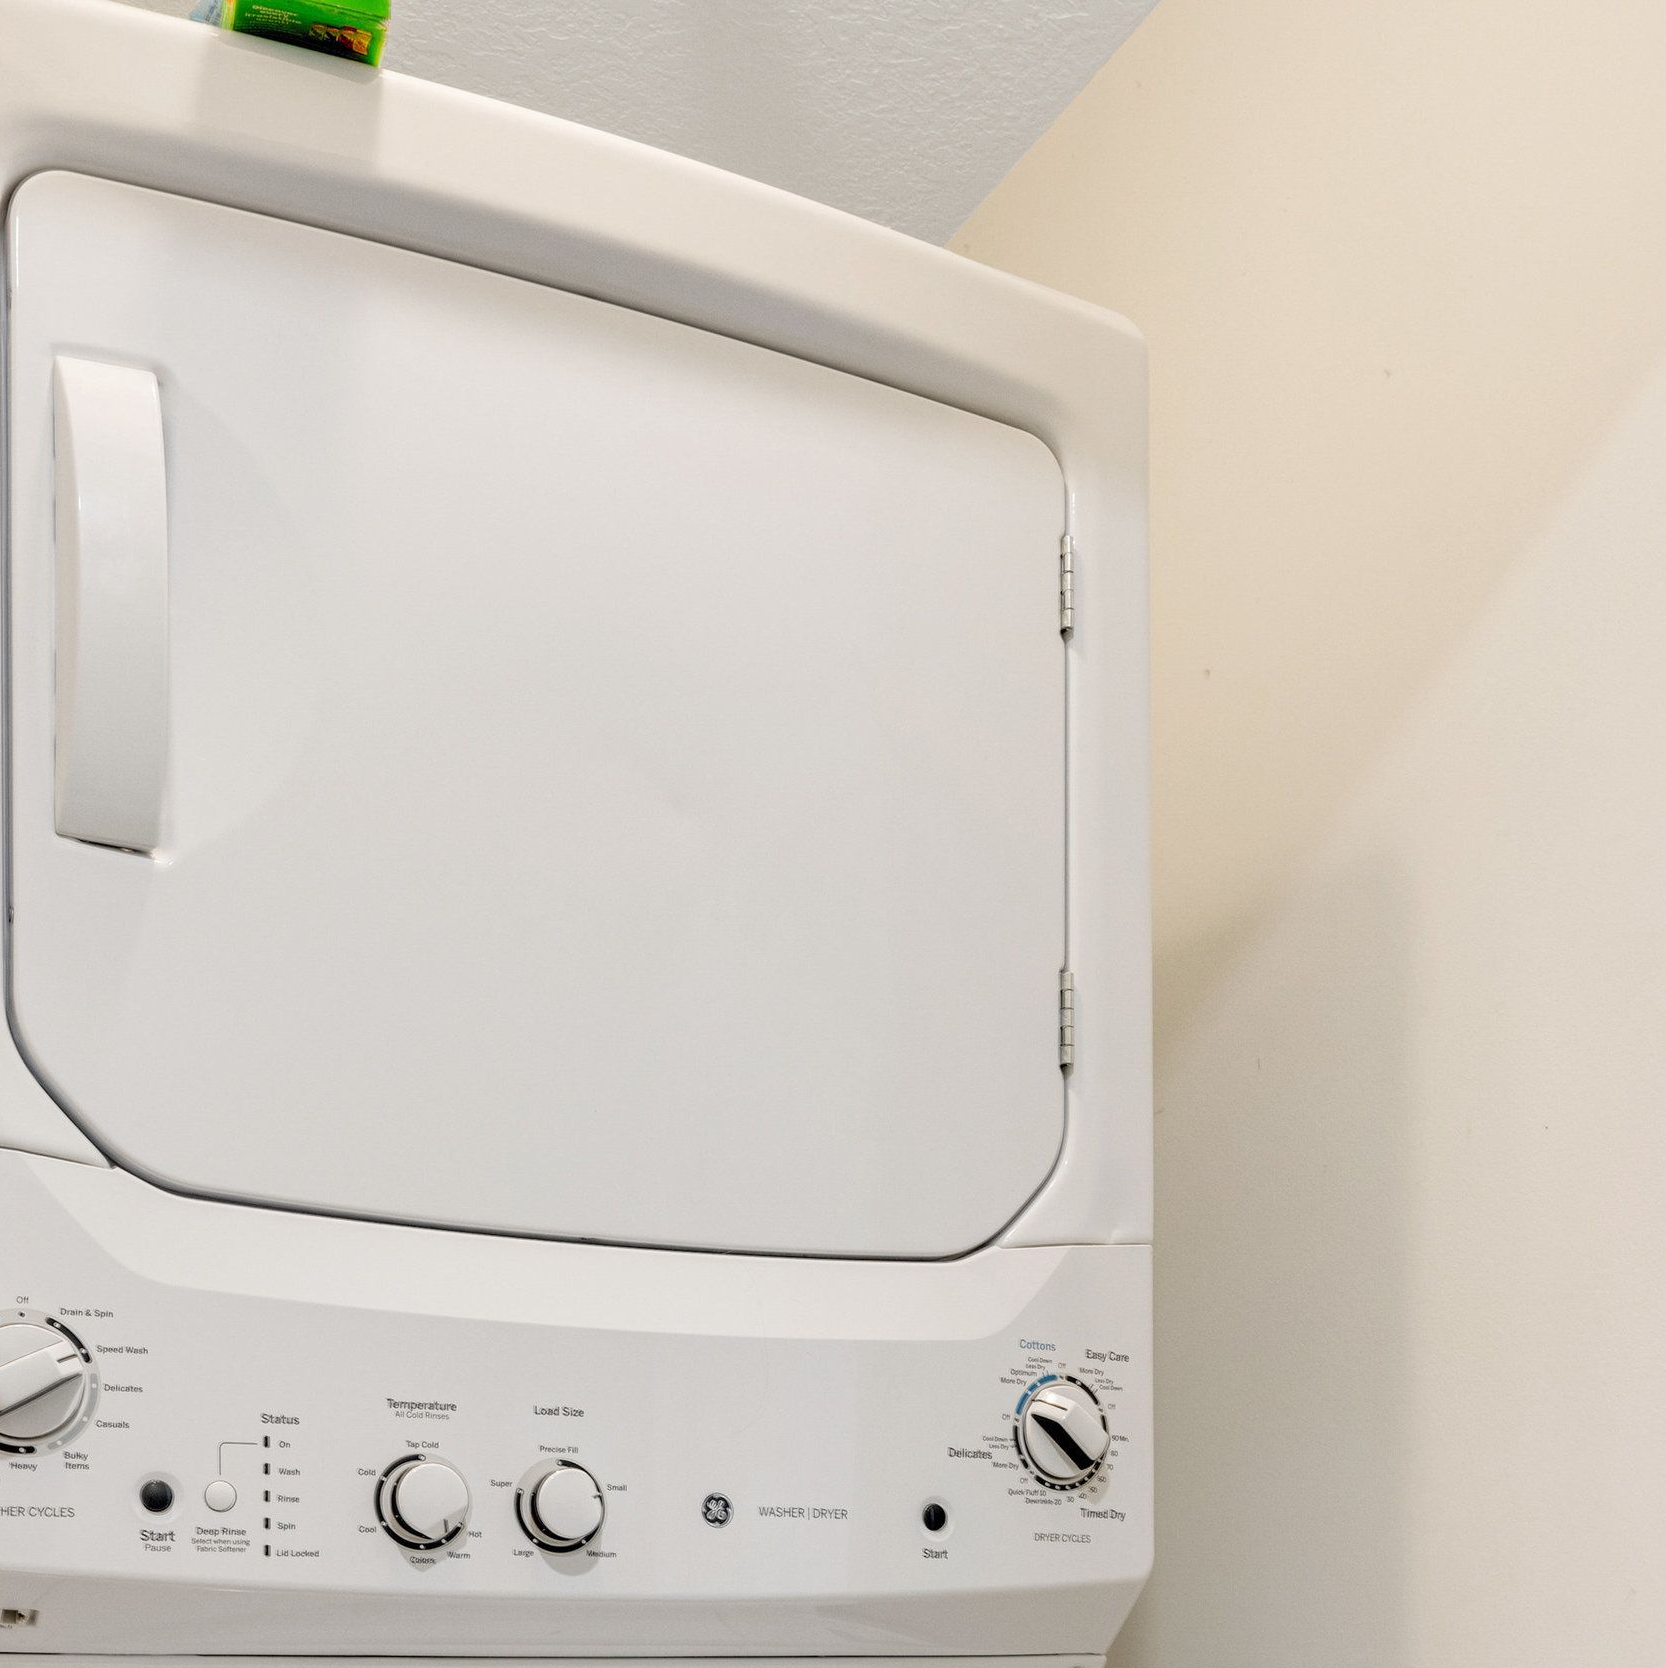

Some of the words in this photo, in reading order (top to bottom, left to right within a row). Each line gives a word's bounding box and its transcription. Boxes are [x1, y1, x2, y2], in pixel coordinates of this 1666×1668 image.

[16, 1296, 29, 1304] Off
[60, 1307, 83, 1317] Drain
[94, 1310, 114, 1319] Spin
[1020, 1339, 1056, 1351] Cottons
[96, 1345, 122, 1355] Speed
[124, 1346, 149, 1355] Wash
[1086, 1349, 1107, 1362] Easy
[1109, 1351, 1130, 1362] Care
[1010, 1369, 1037, 1377] Optimum
[104, 1384, 143, 1393] Delicates
[388, 1399, 457, 1412] Temperature
[534, 1406, 560, 1417] Load
[562, 1407, 585, 1418] Size
[261, 1413, 300, 1425] Status
[96, 1420, 130, 1429] Casuals
[279, 1440, 290, 1448] On
[406, 1440, 420, 1450] Tap
[422, 1441, 439, 1449] Cold
[64, 1452, 89, 1461] Bulky
[948, 1447, 993, 1460] Delicates
[10, 1462, 37, 1471] Heavy
[65, 1462, 89, 1470] Items
[279, 1467, 300, 1476] Wash
[490, 1480, 512, 1489] Super
[607, 1484, 627, 1492] Small
[277, 1495, 300, 1503] Rinse
[28, 1506, 75, 1518] CYCLES
[759, 1506, 805, 1518] WASHER
[813, 1508, 848, 1519] DRYER
[1080, 1508, 1108, 1519] Timed
[1110, 1509, 1126, 1521] Dry
[277, 1522, 296, 1531] Spin
[140, 1530, 175, 1542] Start
[196, 1527, 219, 1537] Deep
[222, 1527, 247, 1536] Rinse
[1034, 1533, 1060, 1542] DRYER
[1062, 1534, 1091, 1543] CYCLES
[145, 1544, 172, 1552] Pause
[276, 1549, 288, 1557] Lid
[291, 1550, 319, 1558] Locked
[447, 1551, 470, 1559] Warm
[513, 1549, 534, 1559] Large
[586, 1550, 617, 1558] Medium
[923, 1548, 948, 1559] Start
